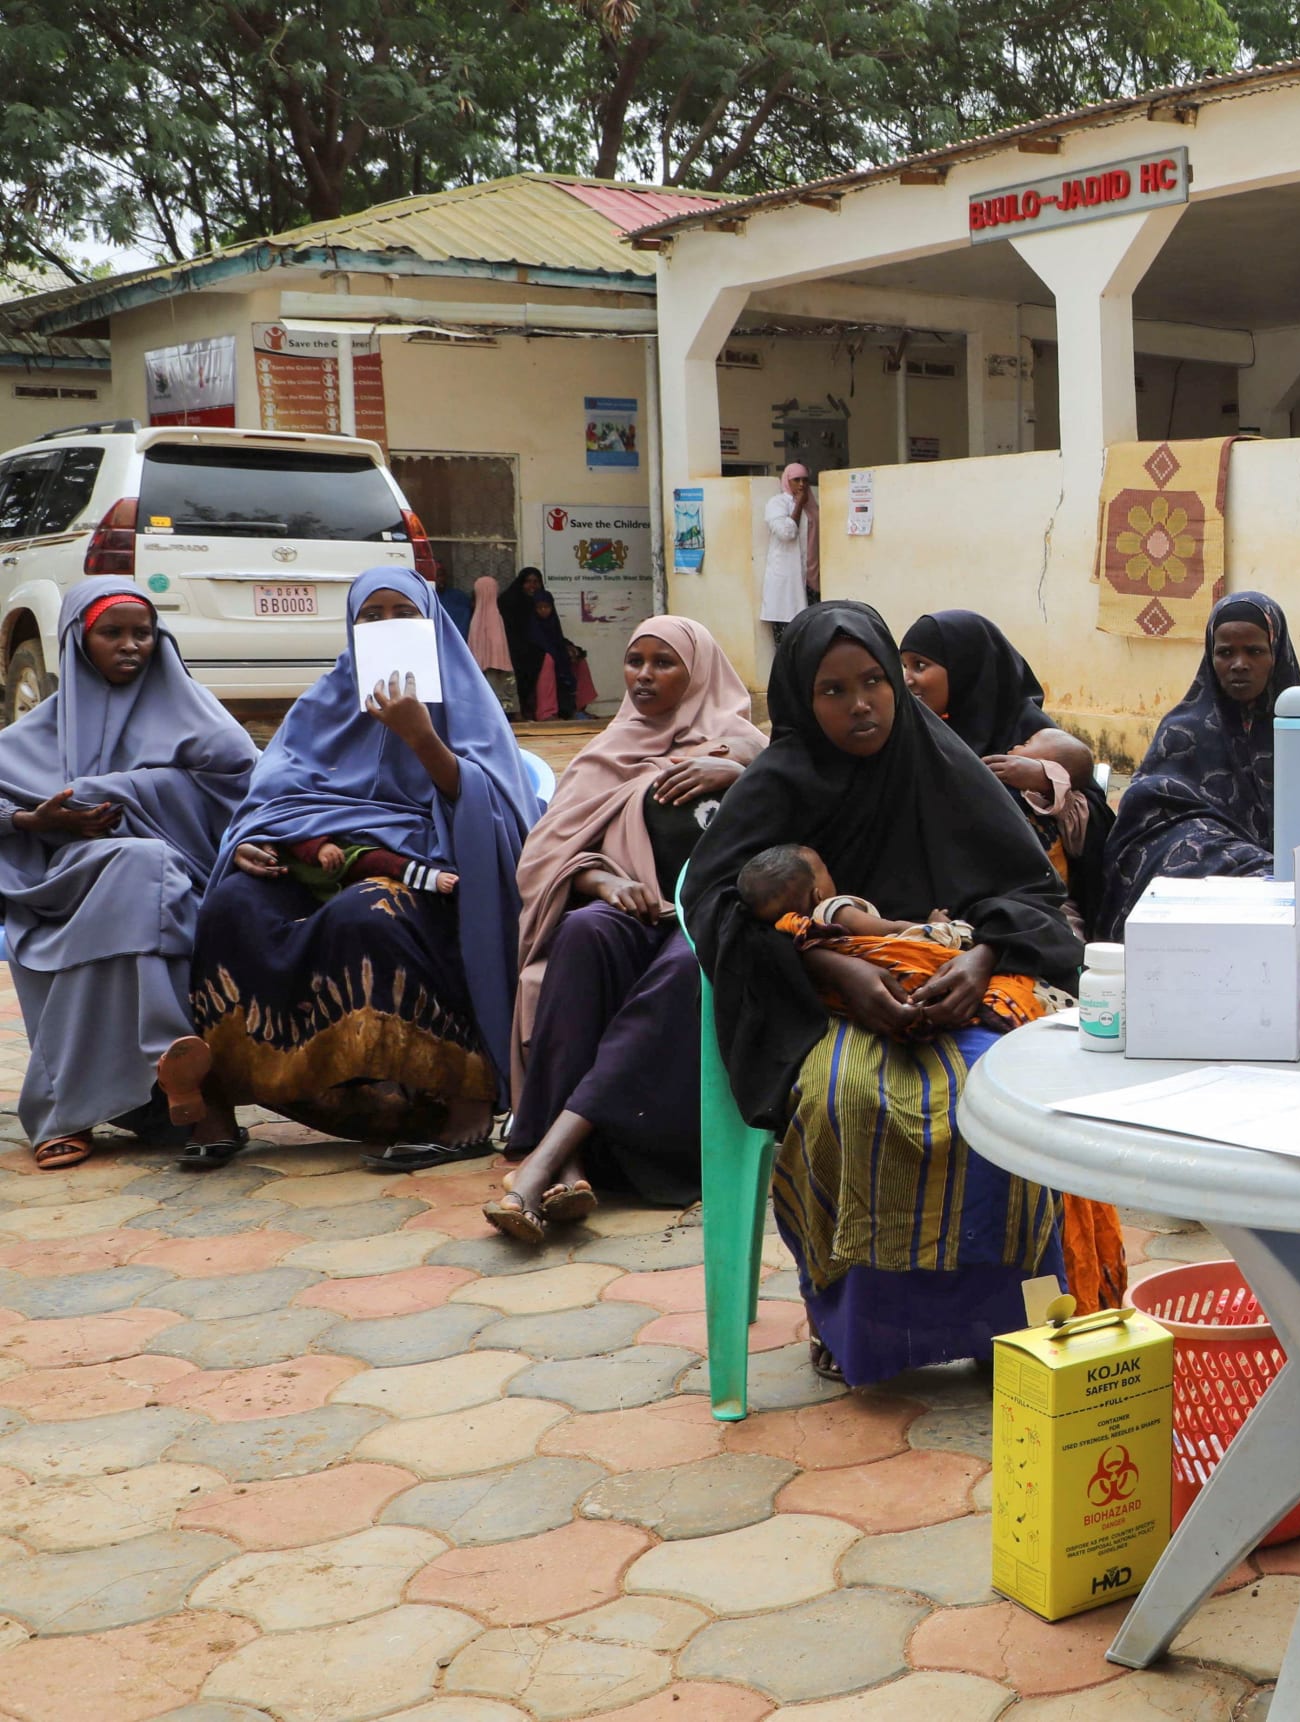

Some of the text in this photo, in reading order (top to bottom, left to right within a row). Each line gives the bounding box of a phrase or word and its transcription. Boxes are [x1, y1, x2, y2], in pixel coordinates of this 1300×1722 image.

[1140, 159, 1177, 193] HC
[288, 340, 311, 348] Save
[313, 340, 330, 348] the
[570, 519, 593, 529] Save
[595, 520, 611, 529] the
[260, 598, 313, 613] BB0003
[1087, 1357, 1141, 1382] KOJAK
[1086, 1375, 1141, 1397] SAFETY BOX
[1104, 1397, 1123, 1407] FULL
[1097, 1413, 1130, 1427] CONTAINER
[1062, 1443, 1078, 1451] USED
[1111, 1426, 1134, 1439] NEEDLES
[1141, 1418, 1161, 1429] SHARPS
[1083, 1499, 1142, 1526] BIOHAZARD
[1102, 1517, 1126, 1530] DANGER
[1092, 1566, 1132, 1594] HMD
